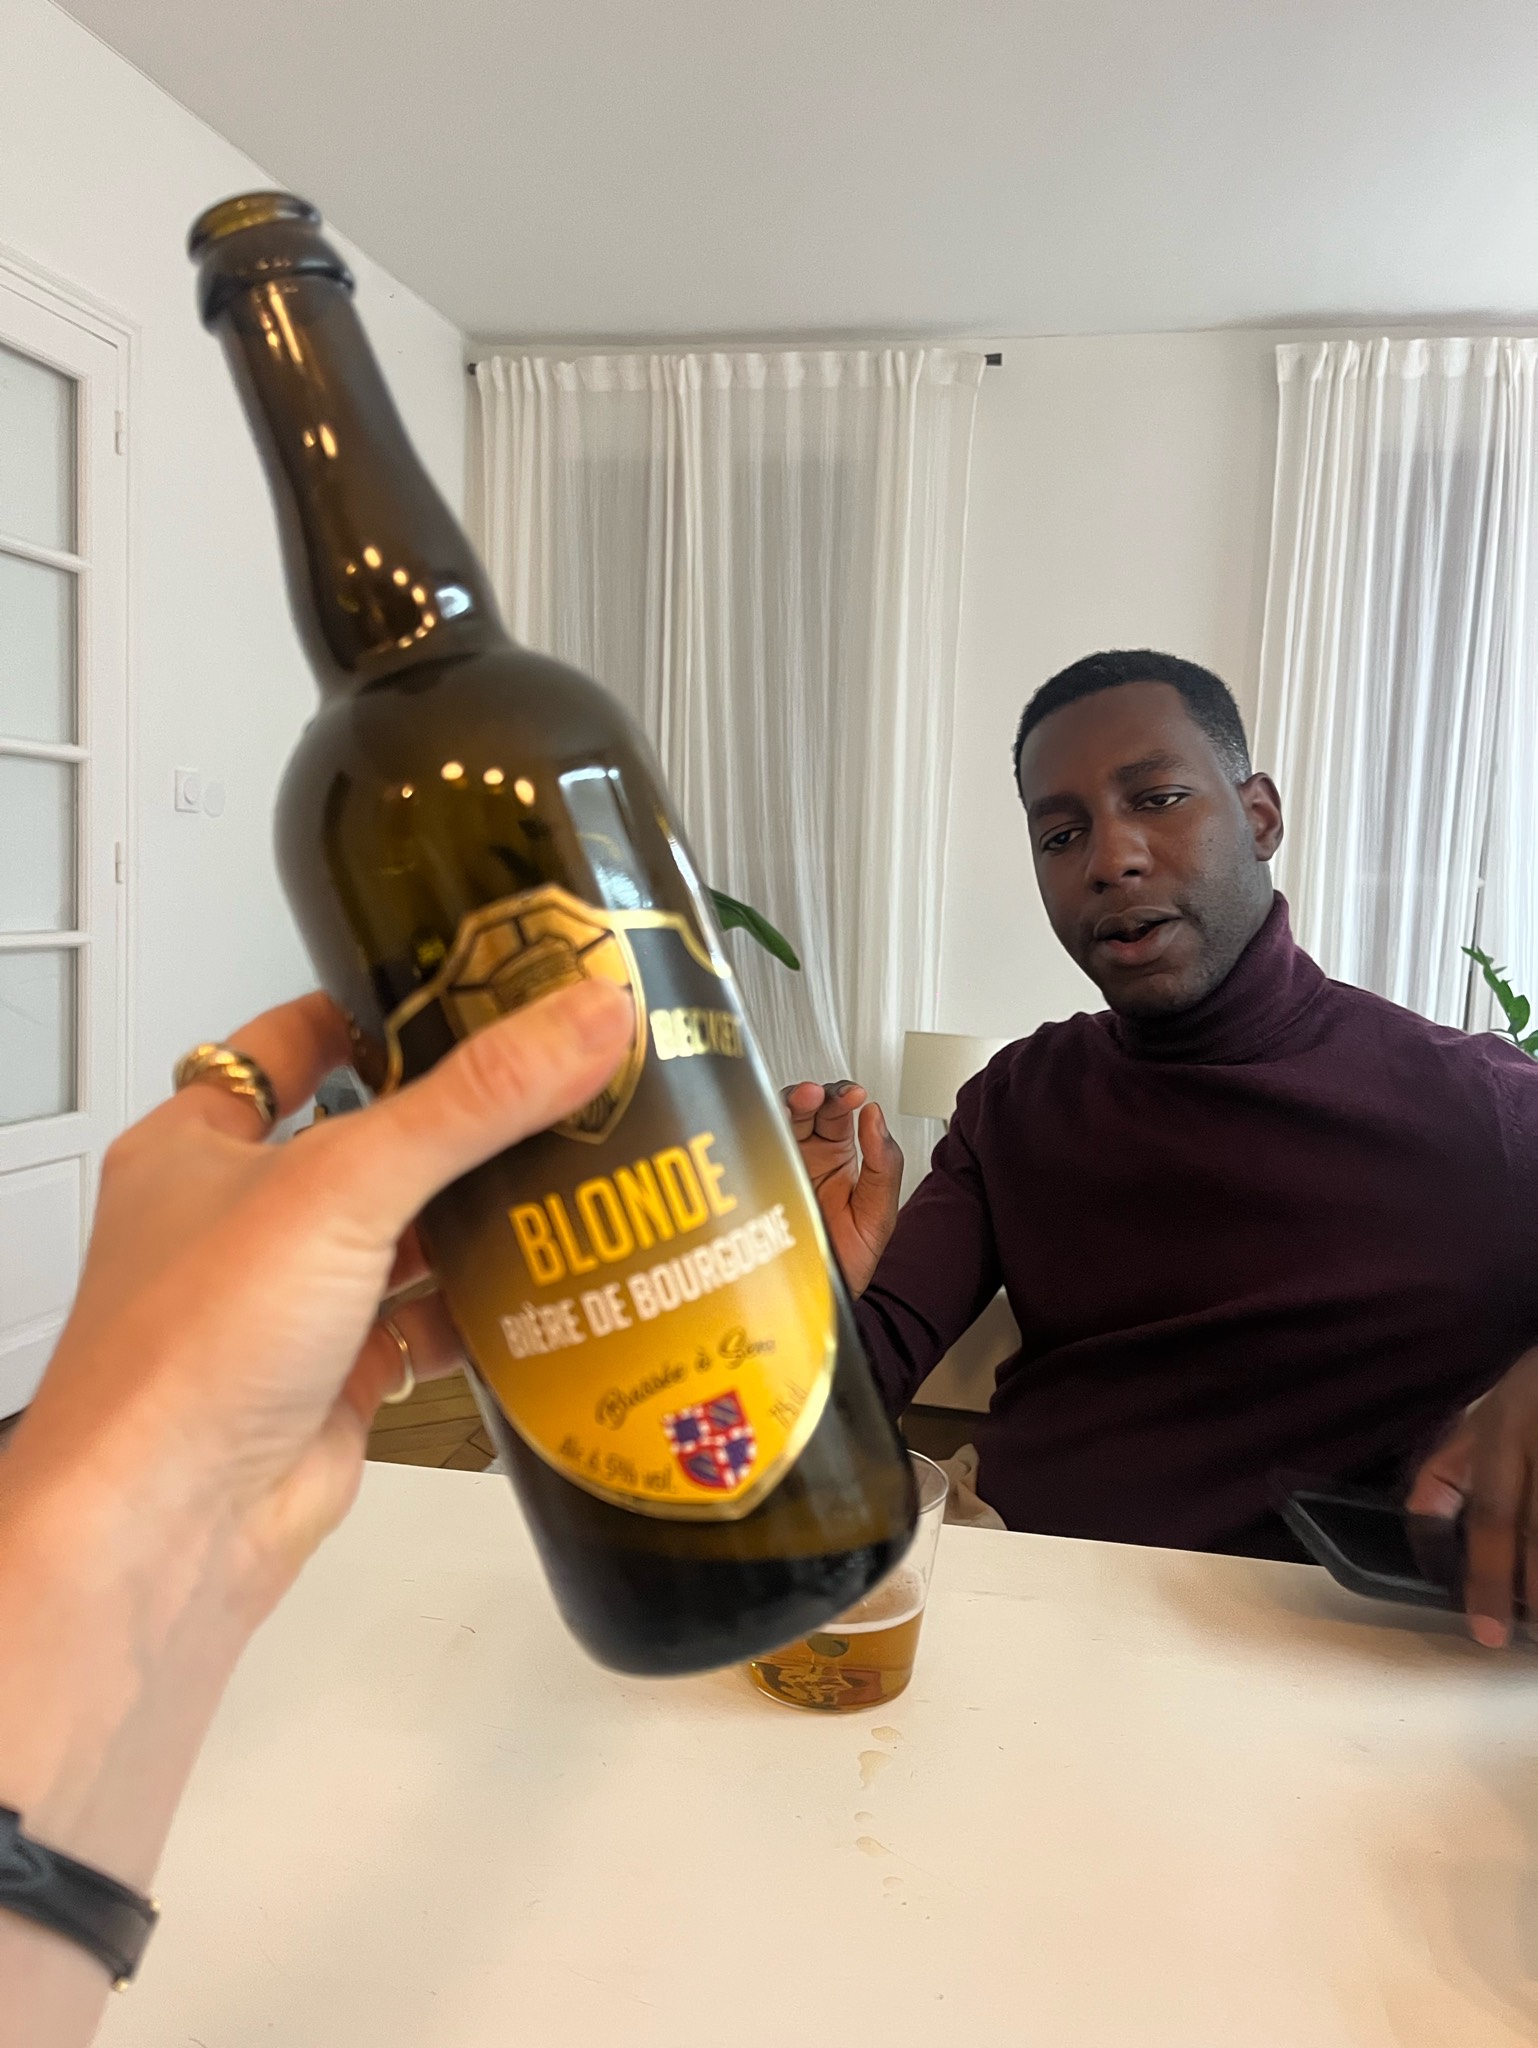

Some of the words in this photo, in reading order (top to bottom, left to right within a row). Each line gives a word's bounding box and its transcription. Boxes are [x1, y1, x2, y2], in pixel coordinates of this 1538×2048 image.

[501, 1301, 586, 1359] BIÈRE
[580, 1283, 632, 1338] DE
[626, 1203, 797, 1322] BOURGOGNE
[509, 1131, 738, 1287] BLONDE
